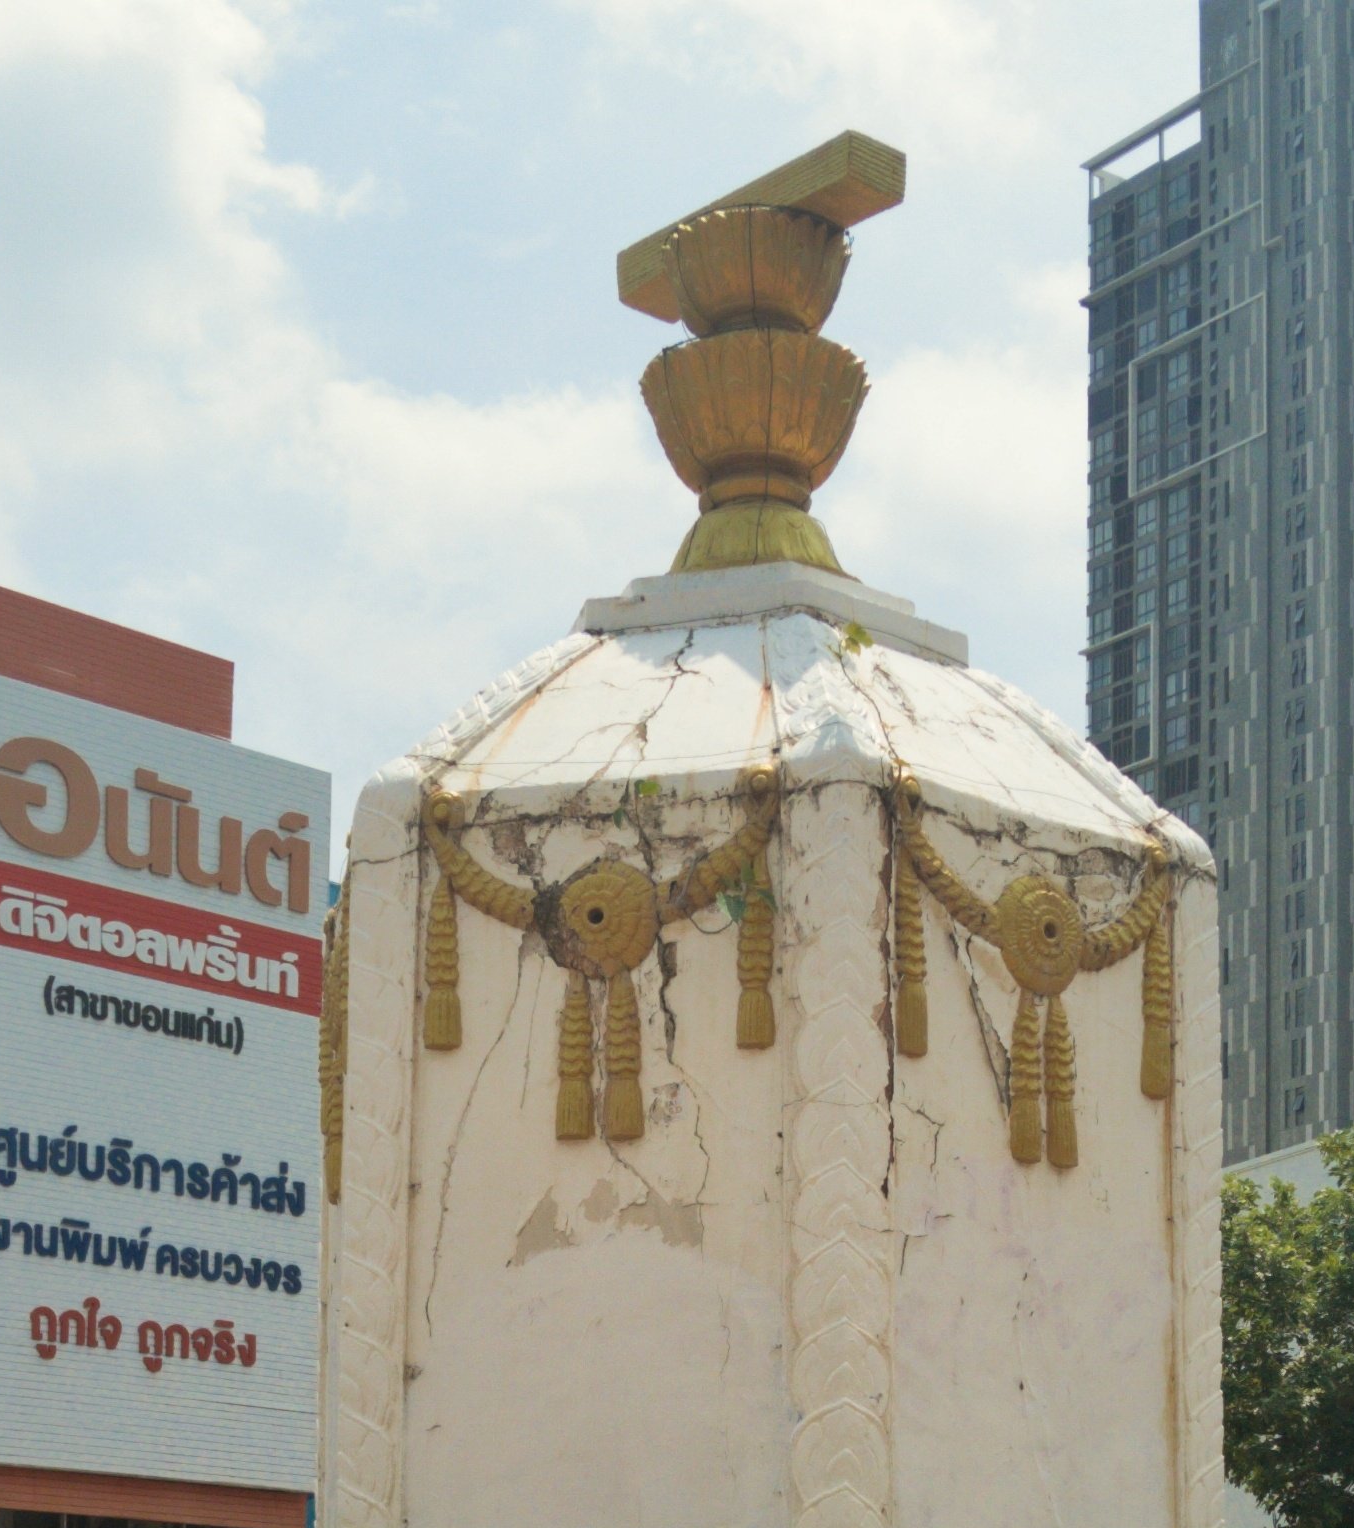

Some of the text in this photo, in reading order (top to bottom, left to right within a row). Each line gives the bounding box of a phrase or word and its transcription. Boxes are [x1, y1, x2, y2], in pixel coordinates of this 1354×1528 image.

[43, 975, 245, 1055] (สาขาขอนแก่น)
[155, 1244, 303, 1295] ครบวงจร
[29, 1296, 258, 1374] ถูกใจ ถูกจริง
